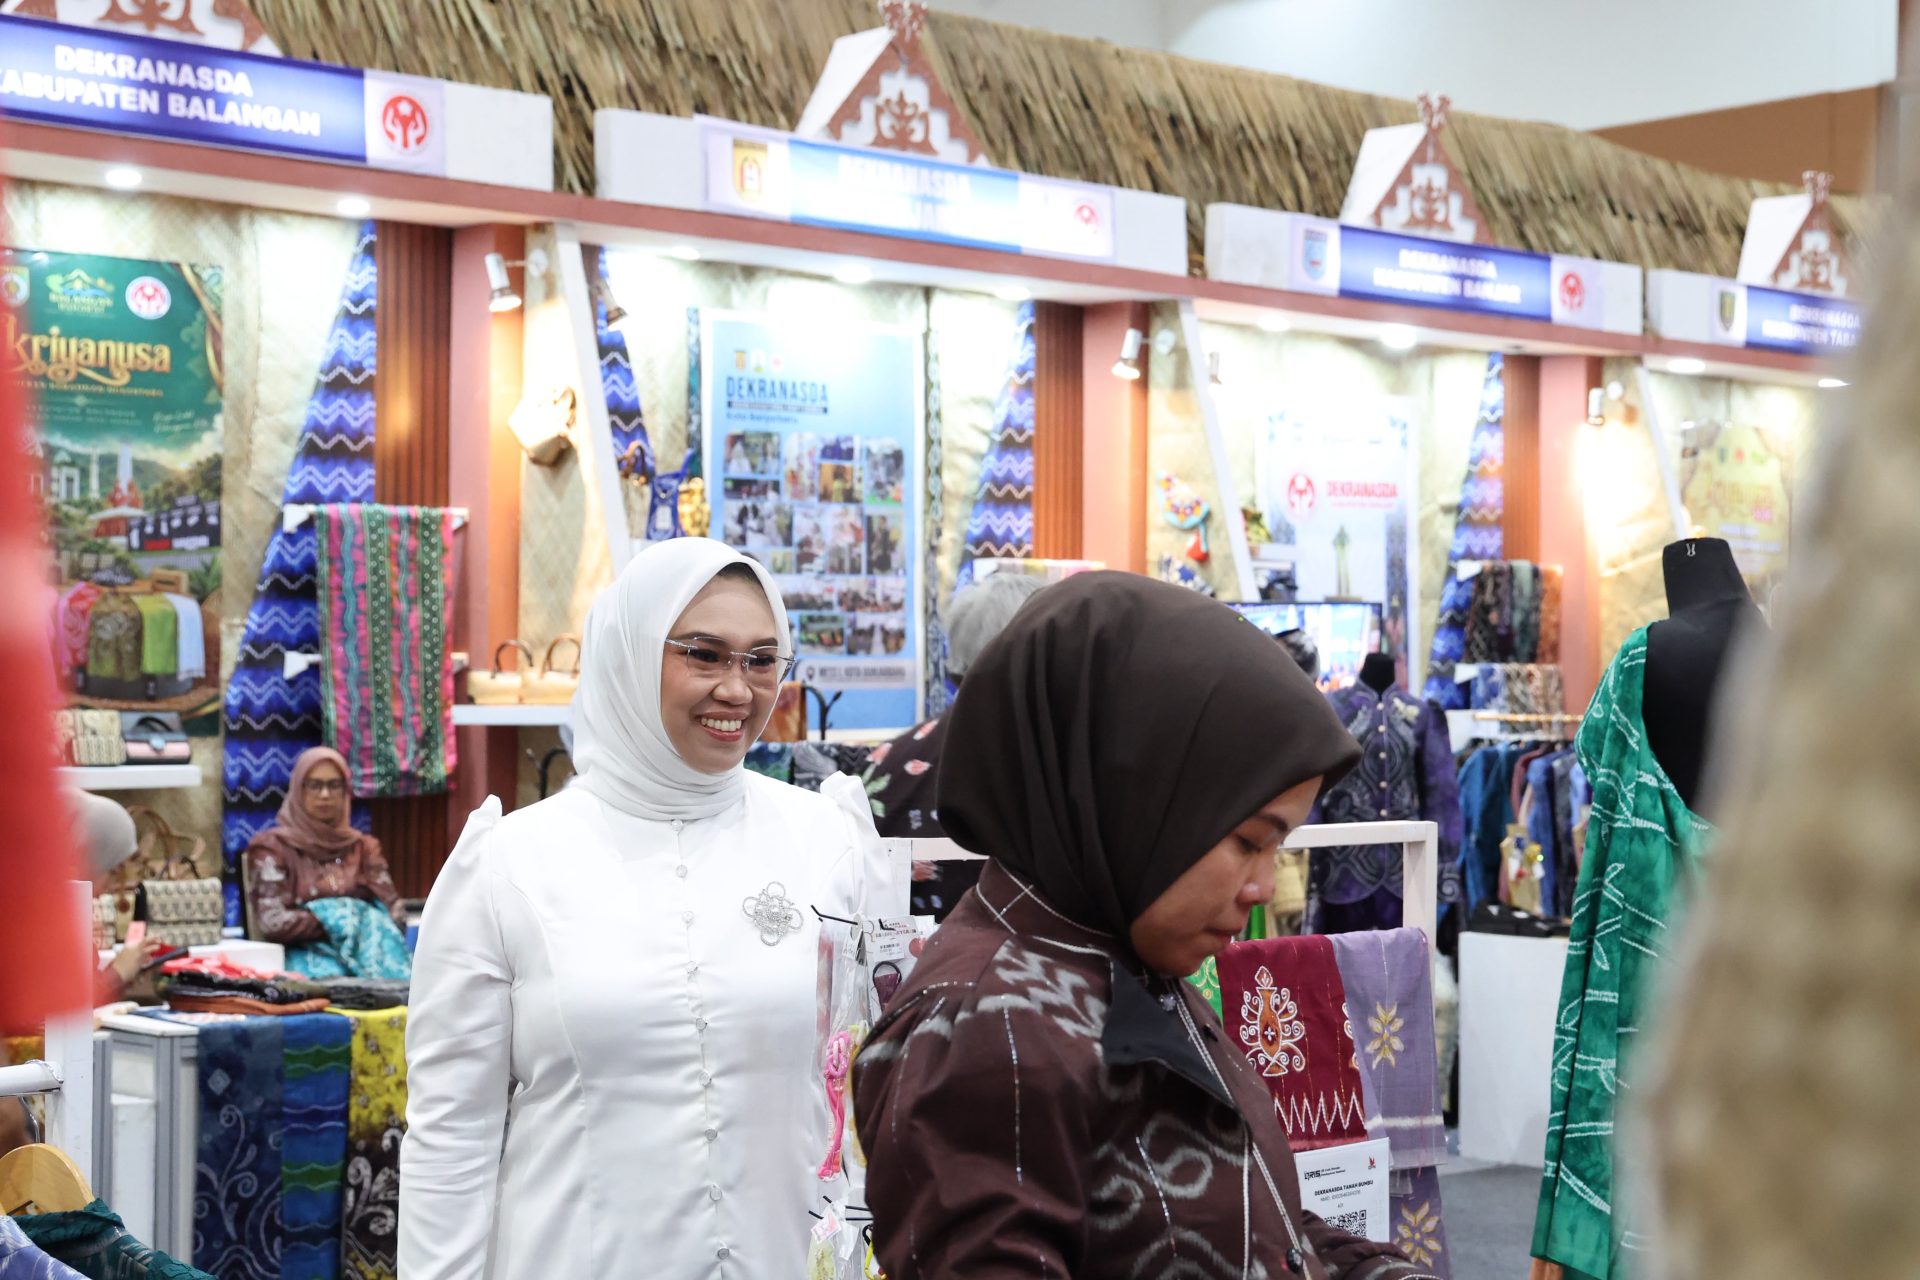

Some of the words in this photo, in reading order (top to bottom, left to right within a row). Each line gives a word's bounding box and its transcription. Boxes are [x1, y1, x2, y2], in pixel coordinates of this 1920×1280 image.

[54, 45, 253, 97] DEKRANASDA
[0, 67, 160, 115] ABUPATEN
[167, 93, 321, 137] BALANGAN
[726, 376, 828, 403] DEKRANASDA
[1327, 481, 1398, 497] DEKRANASDA
[1314, 1185, 1343, 1196] DEKRANASDA
[1343, 1182, 1358, 1190] TANAH
[1358, 1180, 1374, 1188] BUMBU
